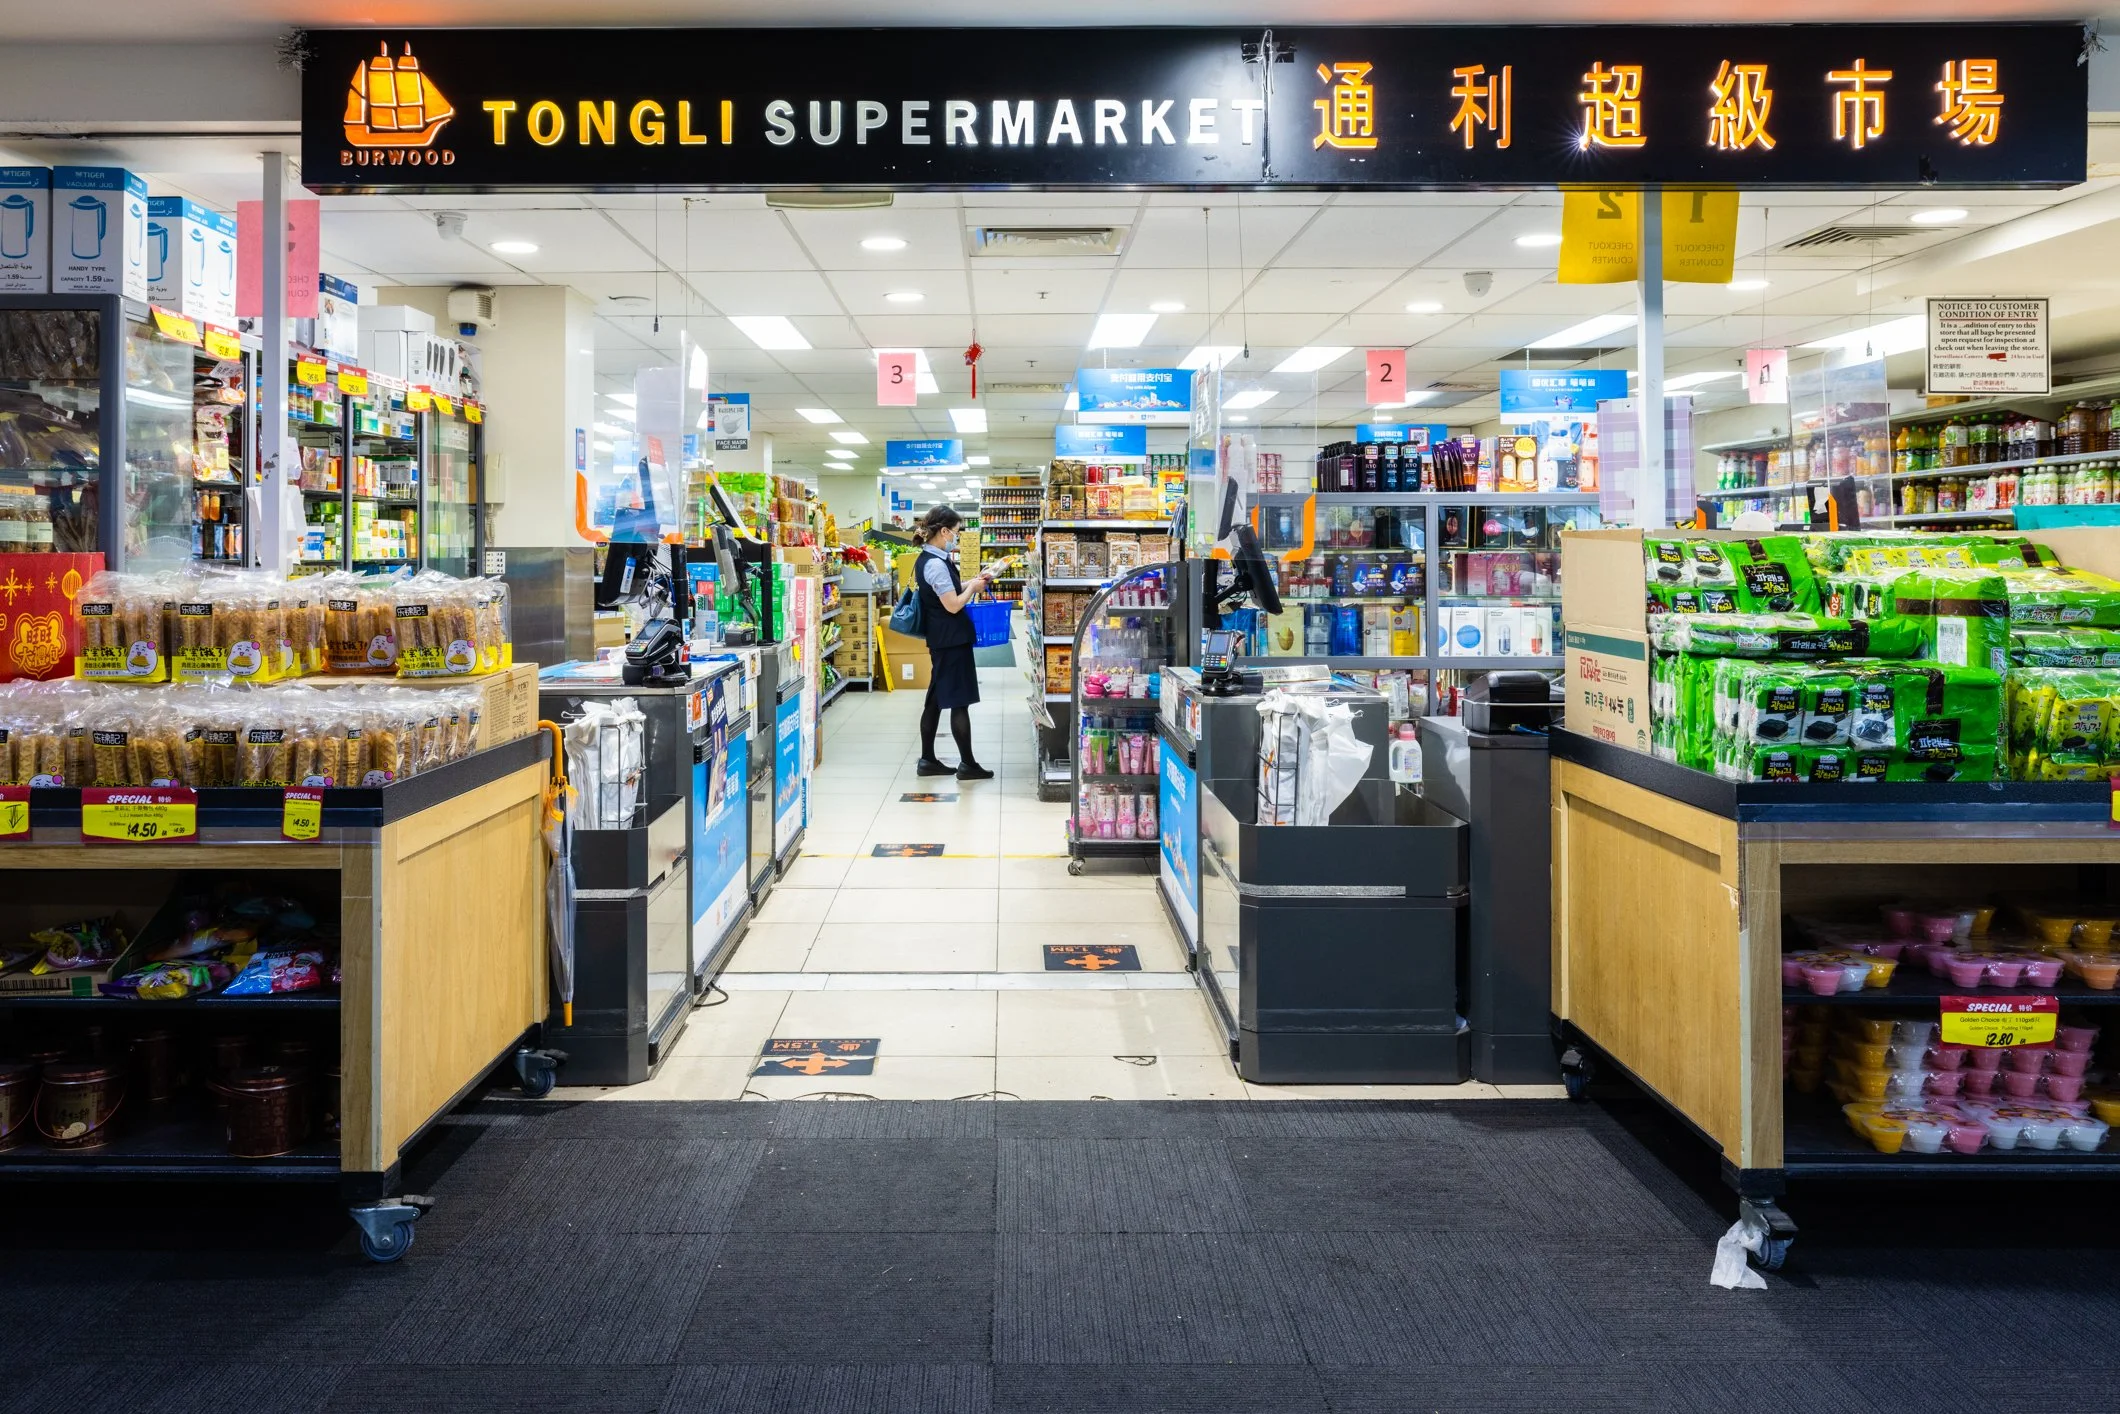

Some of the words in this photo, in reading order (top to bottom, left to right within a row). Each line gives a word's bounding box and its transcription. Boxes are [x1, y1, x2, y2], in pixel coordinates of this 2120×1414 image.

[1312, 58, 2004, 150] 通利超級市場
[483, 100, 733, 146] TONGLI
[764, 98, 1265, 146] SUPERMARKET
[340, 149, 456, 167] BURWOOD
[83, 171, 105, 179] TIGER
[86, 275, 103, 283] 1.59
[1998, 322, 2015, 331] entry
[1980, 329, 1995, 338] bags
[2004, 329, 2036, 338] presented
[1994, 337, 2028, 345] inspection
[1985, 344, 2008, 353] leaving
[890, 364, 904, 385] 3
[1380, 363, 1393, 383] 2
[1762, 363, 1775, 383] 1
[796, 589, 805, 618] LARGE
[26, 626, 52, 645] 旺旺
[107, 795, 152, 804] SPECIAL
[127, 822, 158, 837] $4.50
[293, 819, 310, 827] $4.50
[1967, 1003, 2013, 1012] SPECIAL
[1986, 1033, 2014, 1046] $2.80
